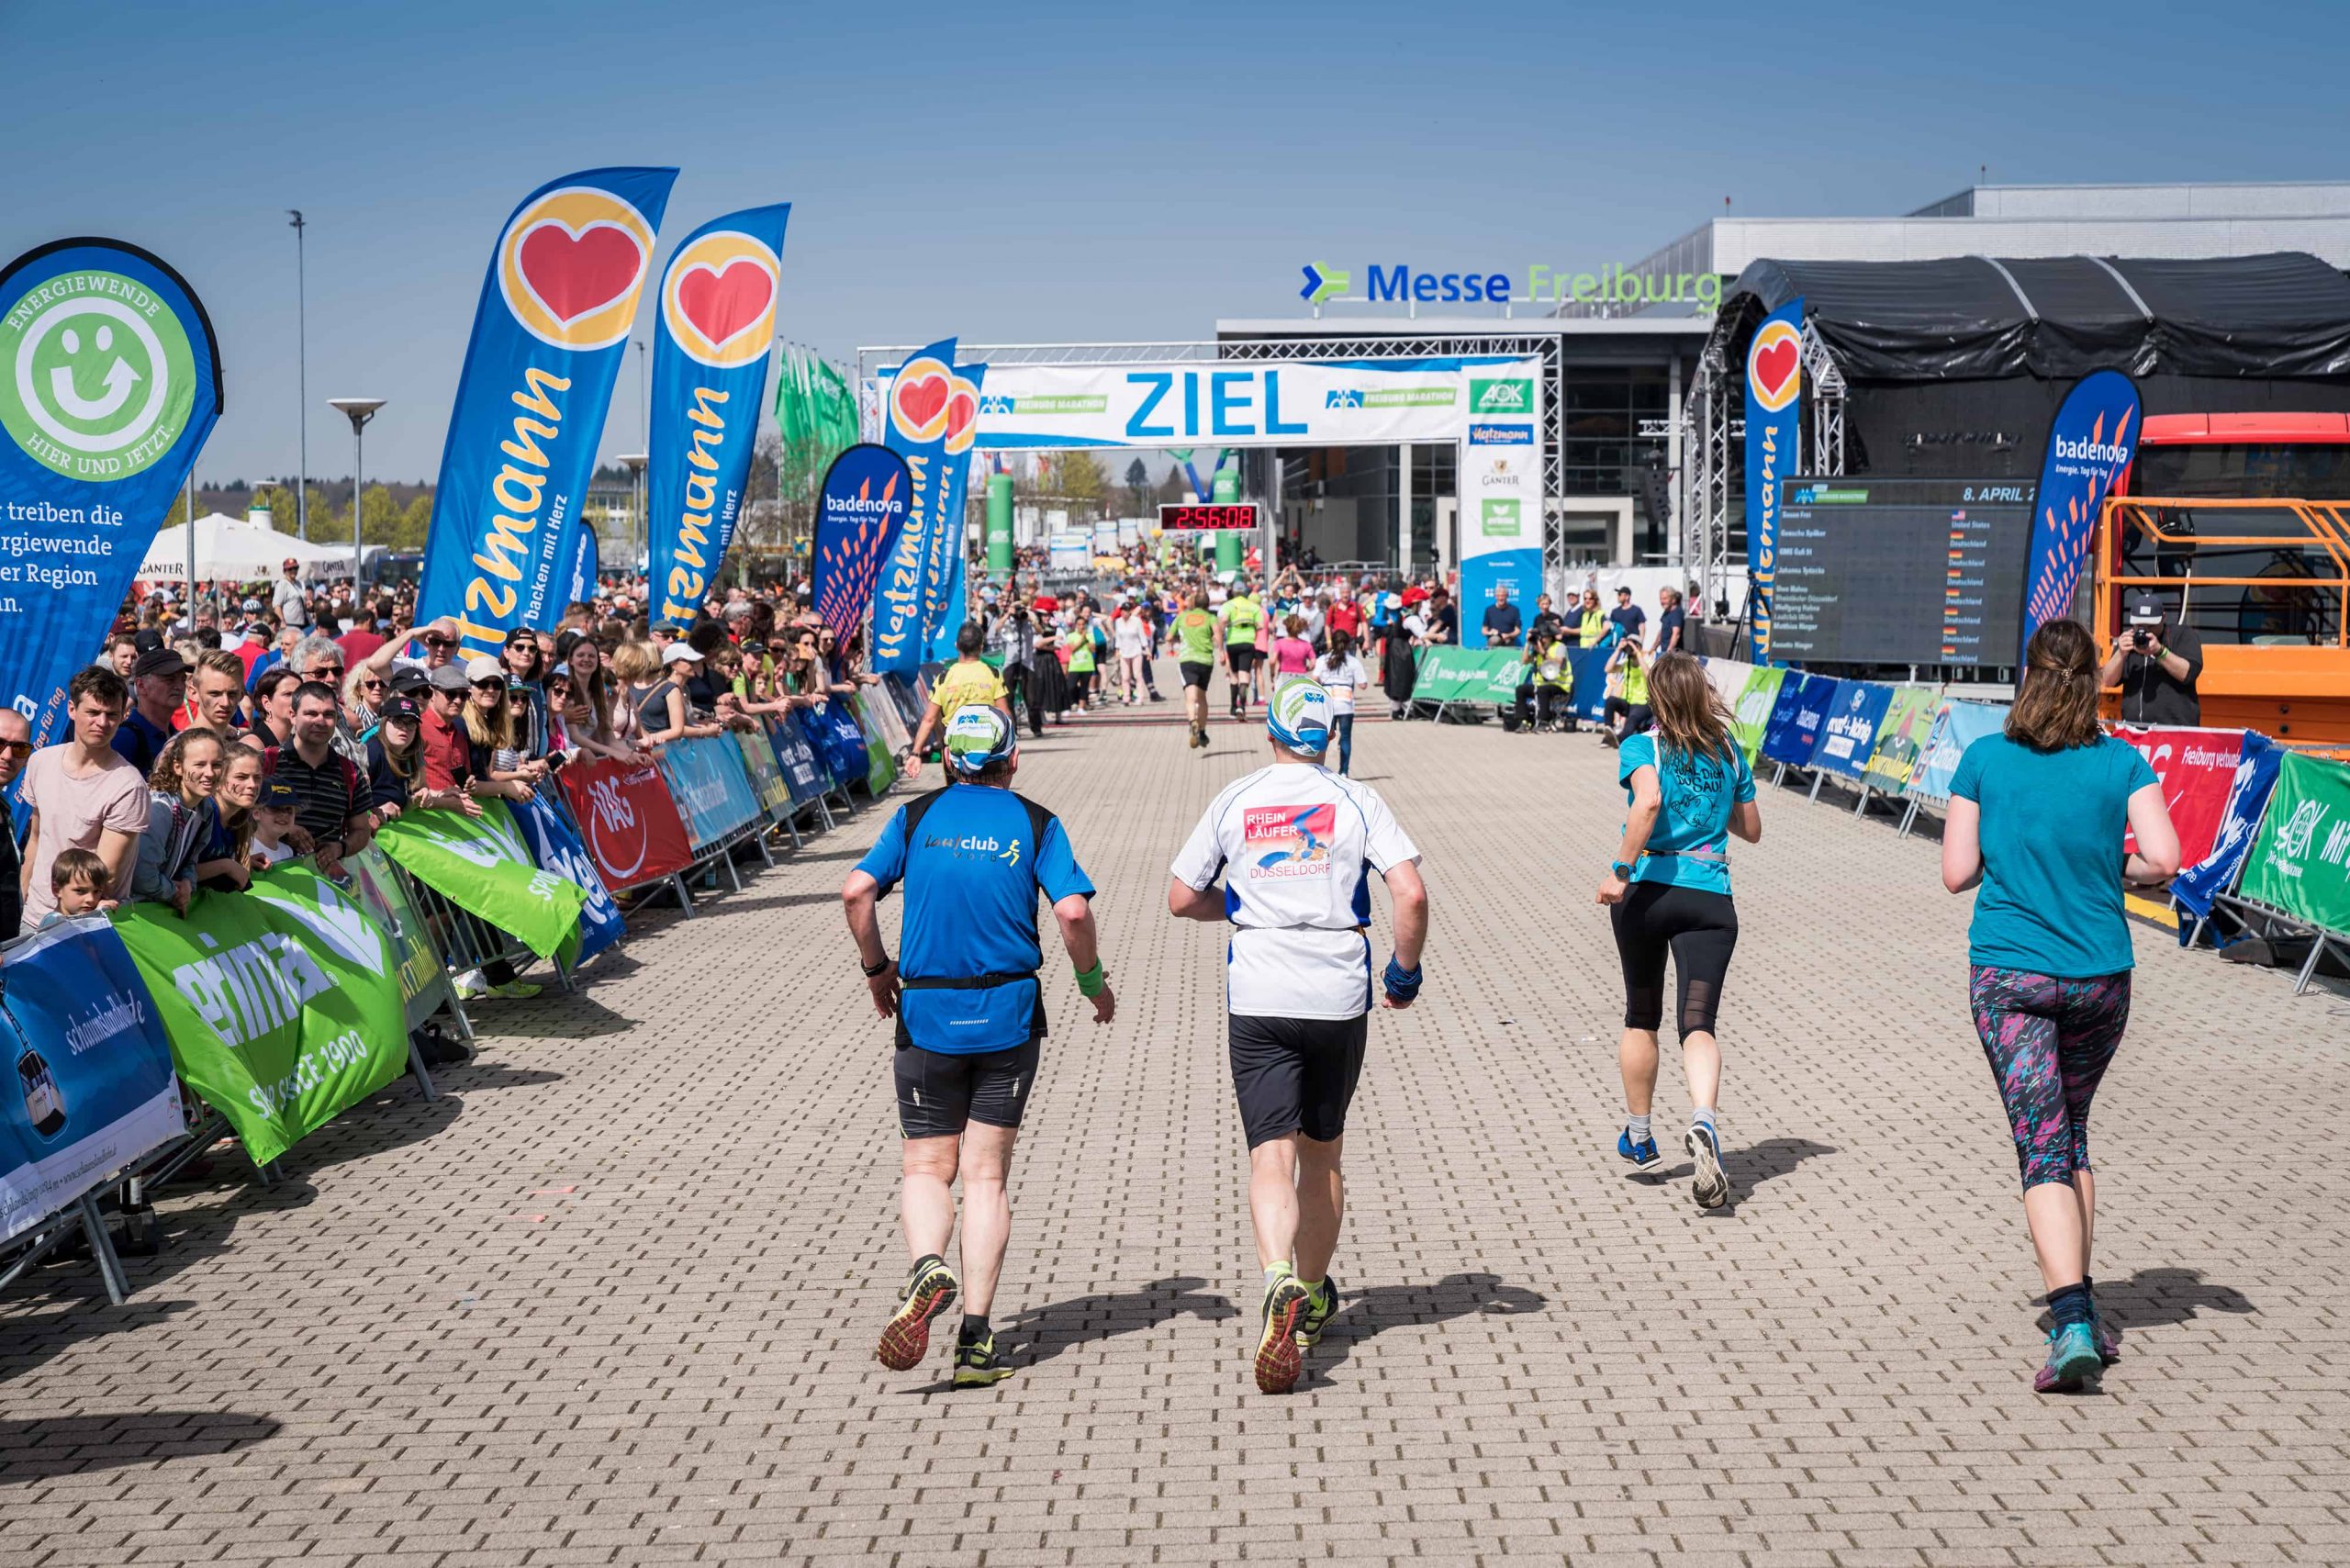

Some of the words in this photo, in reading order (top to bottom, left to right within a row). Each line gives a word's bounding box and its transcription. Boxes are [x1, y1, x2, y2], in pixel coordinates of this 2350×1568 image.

[1367, 264, 1511, 302] Messe
[1528, 263, 1723, 313] Freiburg
[7, 276, 160, 331] ENERGIEWENDE
[1125, 370, 1308, 437] ZIEL
[1479, 384, 1524, 402] AOK
[26, 431, 72, 469] HIER
[78, 457, 120, 474] UND
[124, 424, 174, 468] JETZT.
[2055, 434, 2128, 464] badenova
[1482, 476, 1519, 486] GANTER
[2055, 464, 2079, 476] Energie.
[2080, 466, 2090, 476] Tag
[722, 489, 738, 520] Herz
[826, 494, 902, 513] badenova
[1963, 487, 1975, 501] 8.
[1978, 487, 2023, 501] APRIL
[7, 502, 85, 523] treiben
[91, 505, 123, 526] die
[547, 494, 568, 531] Herz
[1176, 507, 1252, 530] 2:56:08
[543, 532, 558, 560] mit
[720, 524, 733, 546] mit
[1950, 540, 1986, 548] Deutschland
[26, 564, 98, 589] Region
[138, 562, 184, 576] GANTER
[322, 559, 346, 573] GANTER
[524, 562, 551, 621] backen
[1946, 597, 1982, 605] Deutschland
[1944, 616, 1981, 624] Deutschland
[1942, 635, 1979, 644] Deutschland
[1942, 654, 1978, 662] Deutschland
[40, 710, 55, 731] für
[48, 686, 66, 710] Tag
[2181, 745, 2216, 772] Freiburg
[1247, 812, 1286, 825] RHEIN
[1248, 824, 1298, 839] LÄUFER
[320, 1029, 367, 1074] 1900
